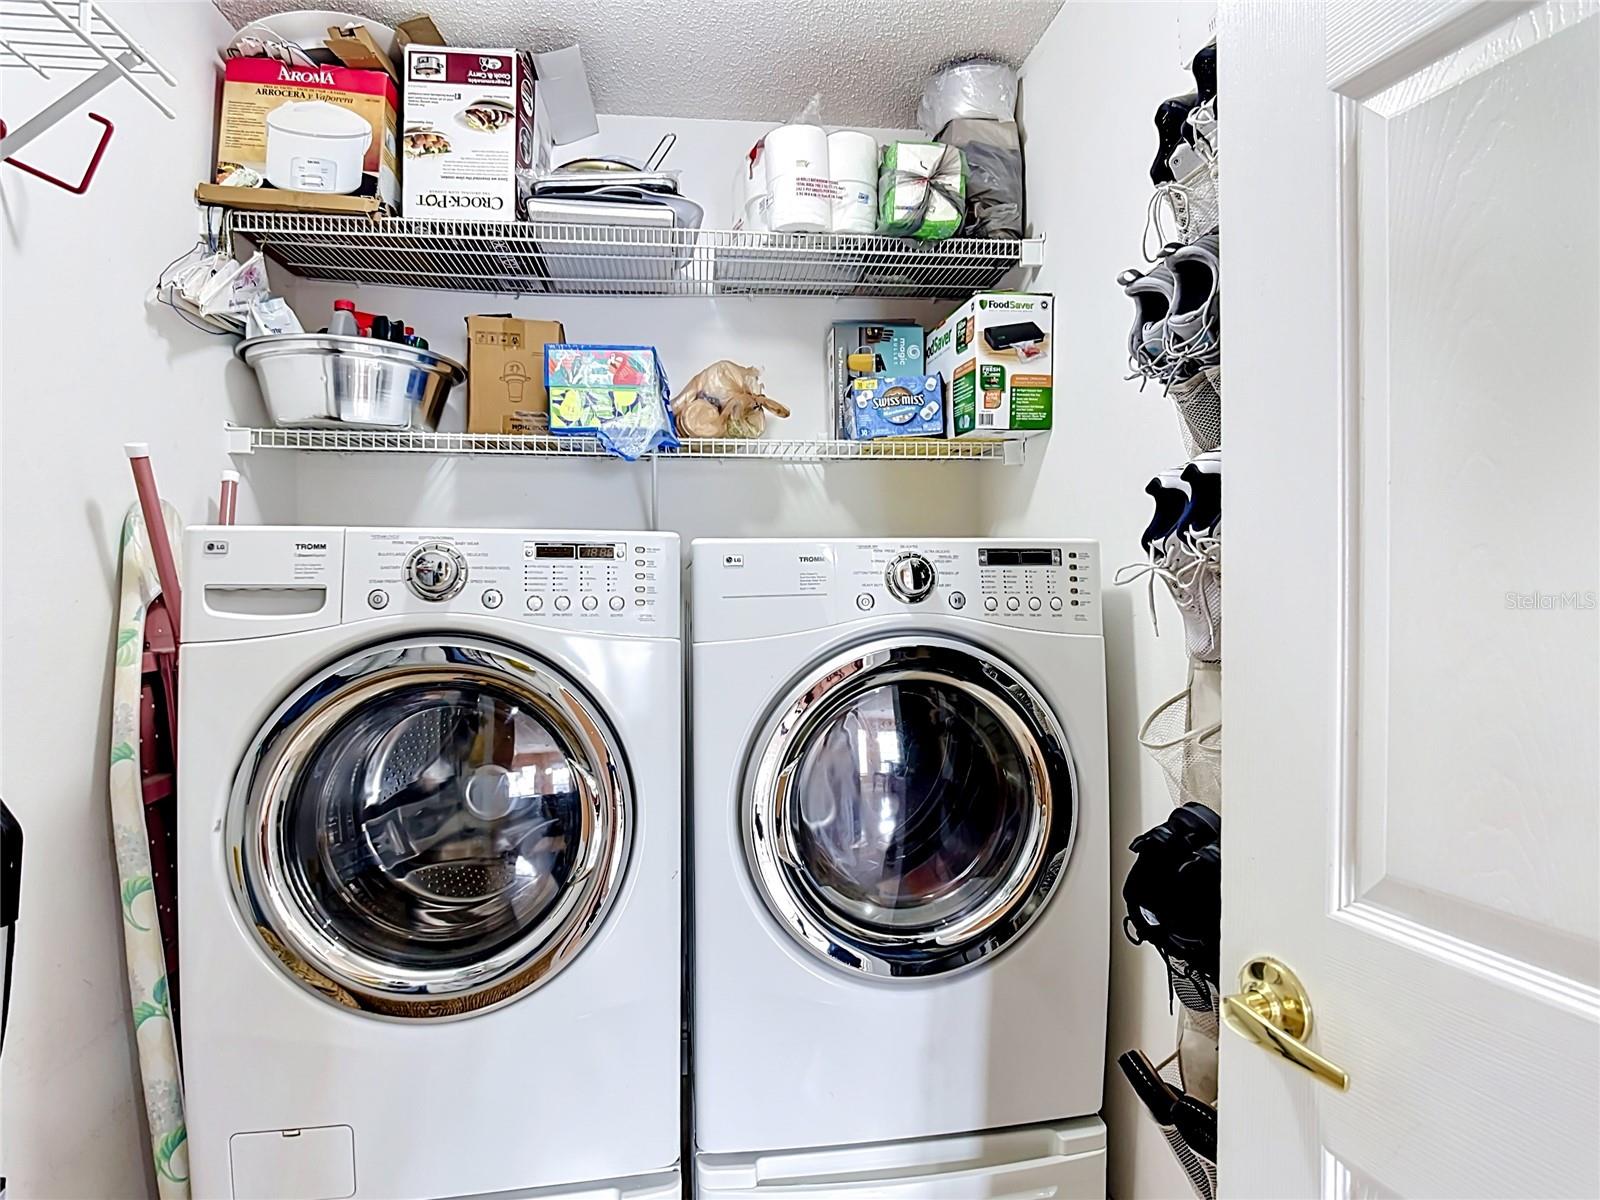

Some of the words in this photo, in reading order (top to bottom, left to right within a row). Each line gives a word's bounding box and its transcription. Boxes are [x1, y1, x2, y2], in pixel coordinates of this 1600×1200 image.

[278, 68, 335, 85] AROMA
[255, 88, 306, 98] ARROCERA
[315, 93, 354, 104] Vaporera
[988, 300, 1034, 310] FoodSaver
[898, 337, 907, 366] magic
[926, 328, 952, 358] odSaver
